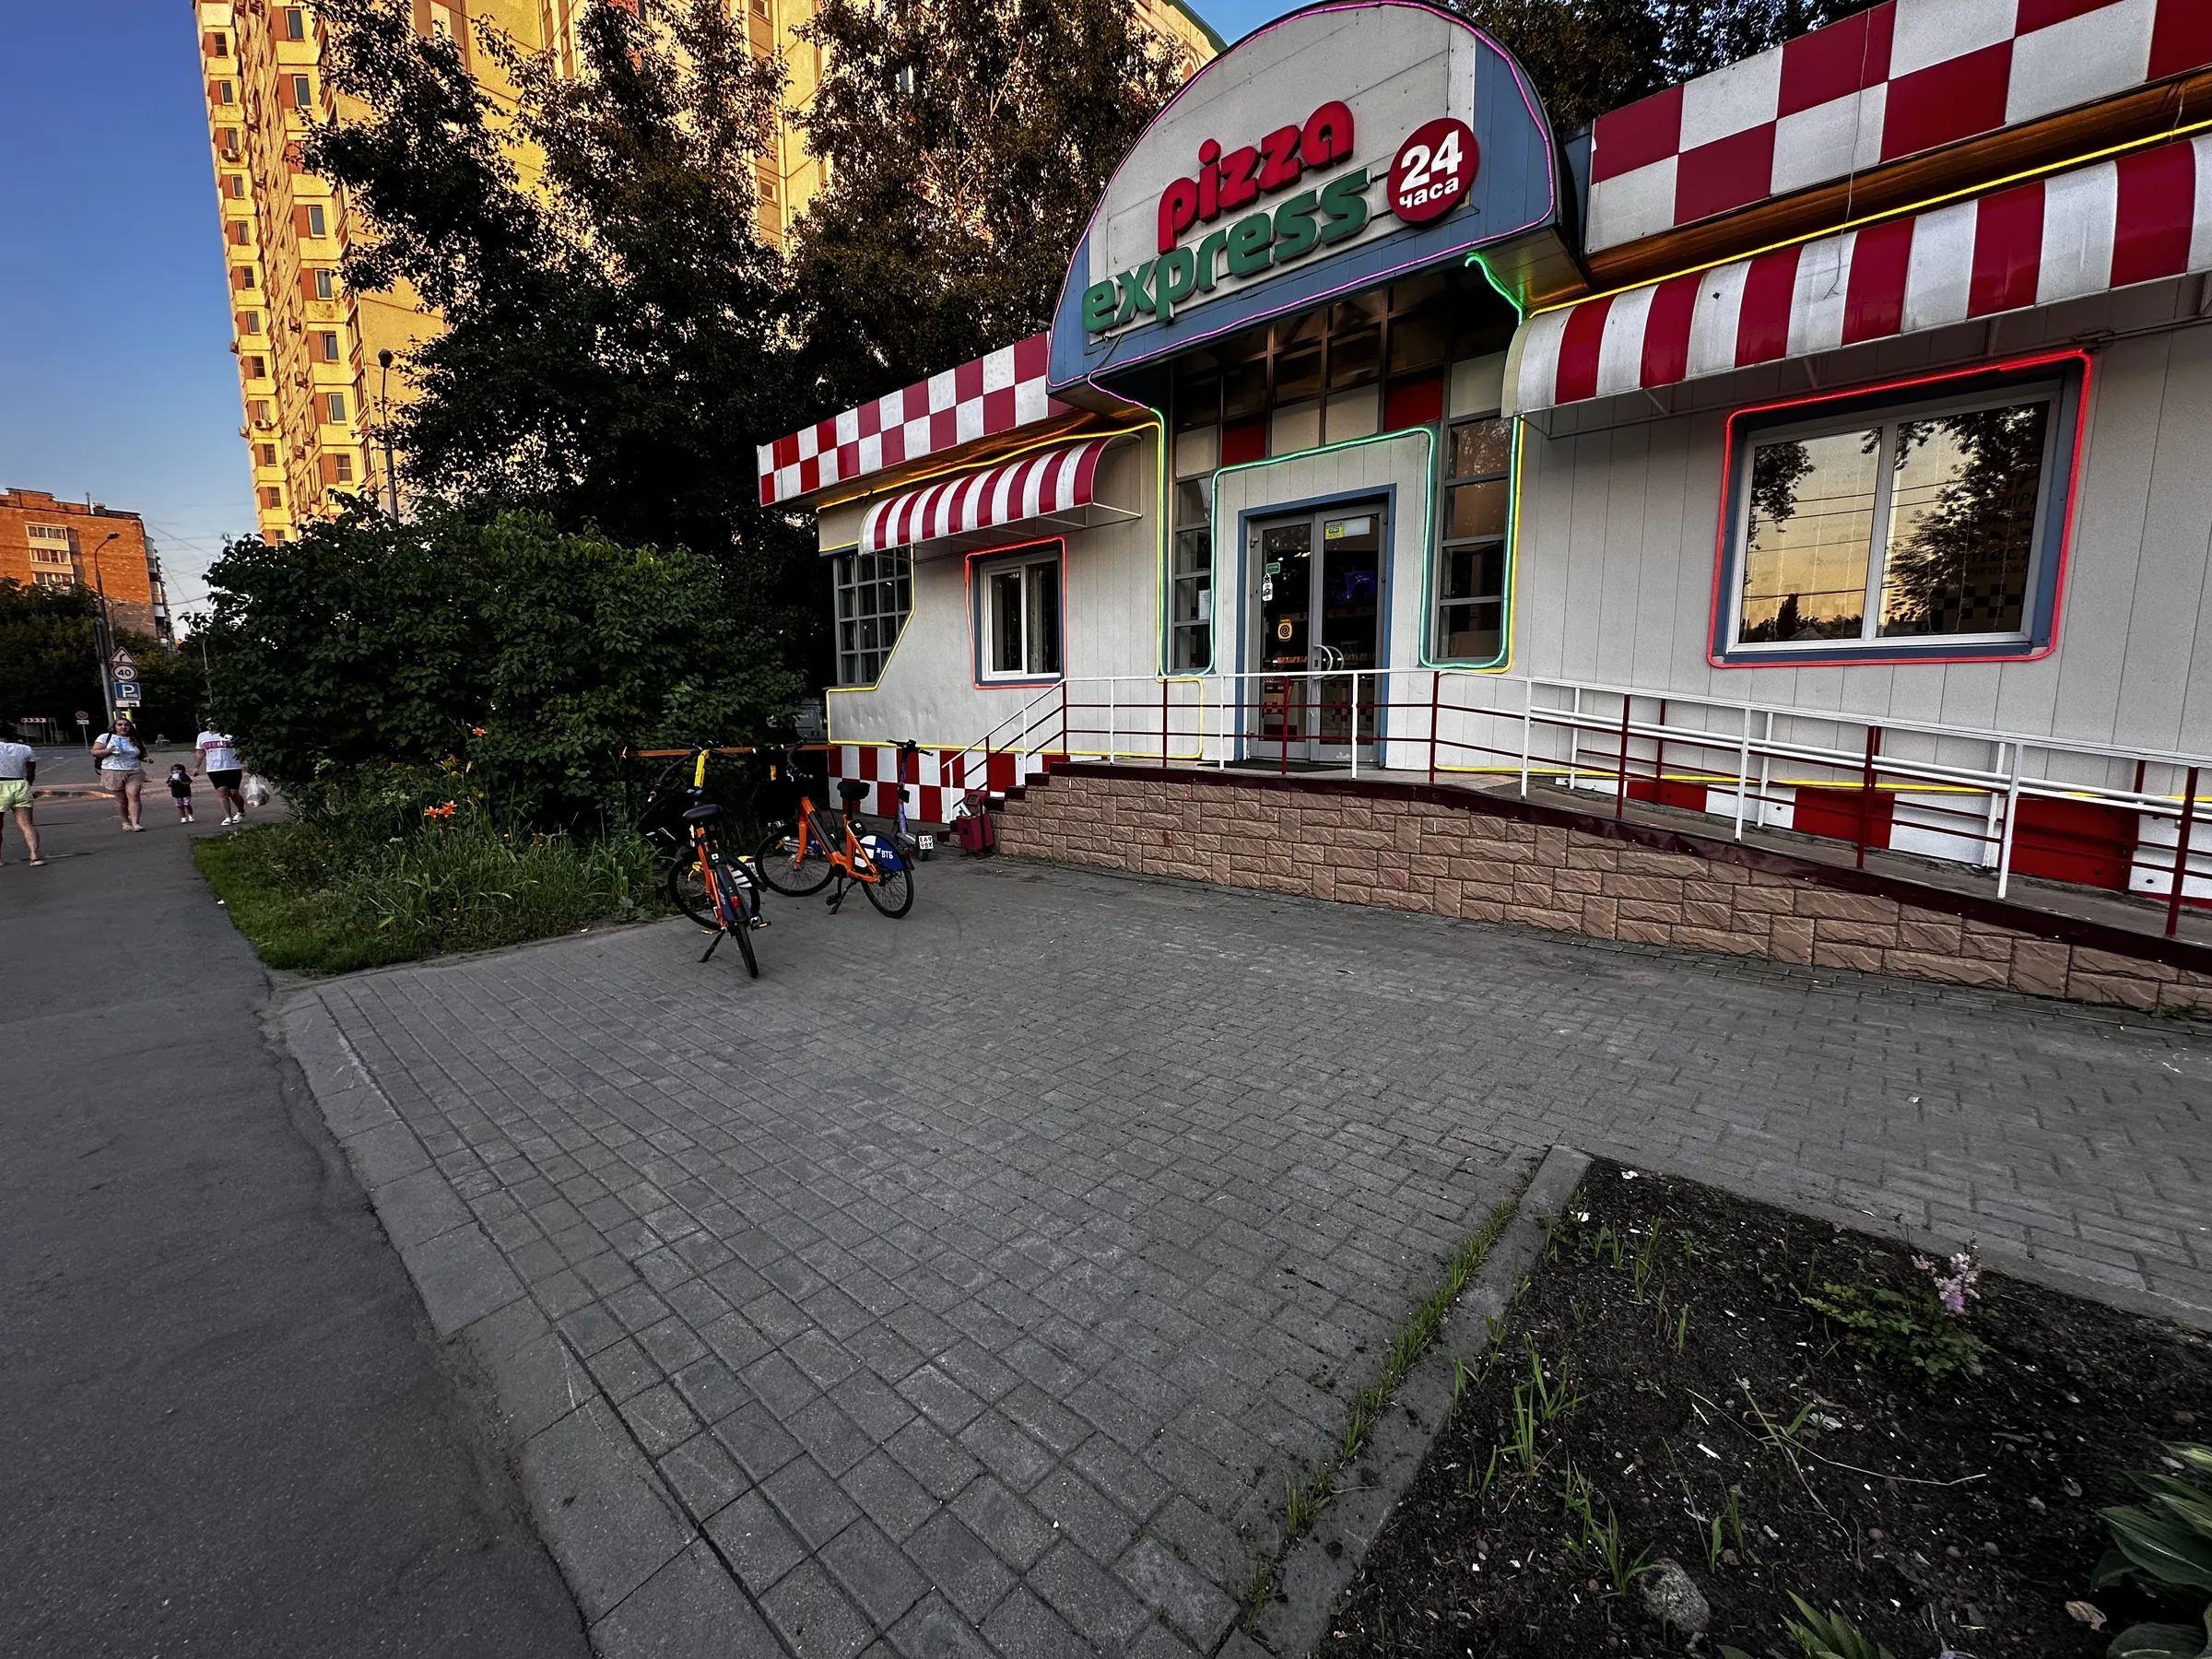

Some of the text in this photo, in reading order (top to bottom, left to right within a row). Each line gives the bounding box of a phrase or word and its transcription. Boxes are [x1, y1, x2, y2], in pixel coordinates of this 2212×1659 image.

[1158, 100, 1354, 255] pizza
[1400, 129, 1463, 193] 24
[1399, 177, 1459, 209] часа
[1081, 168, 1370, 333] express
[122, 684, 135, 698] P
[881, 850, 893, 859] ВТБ
